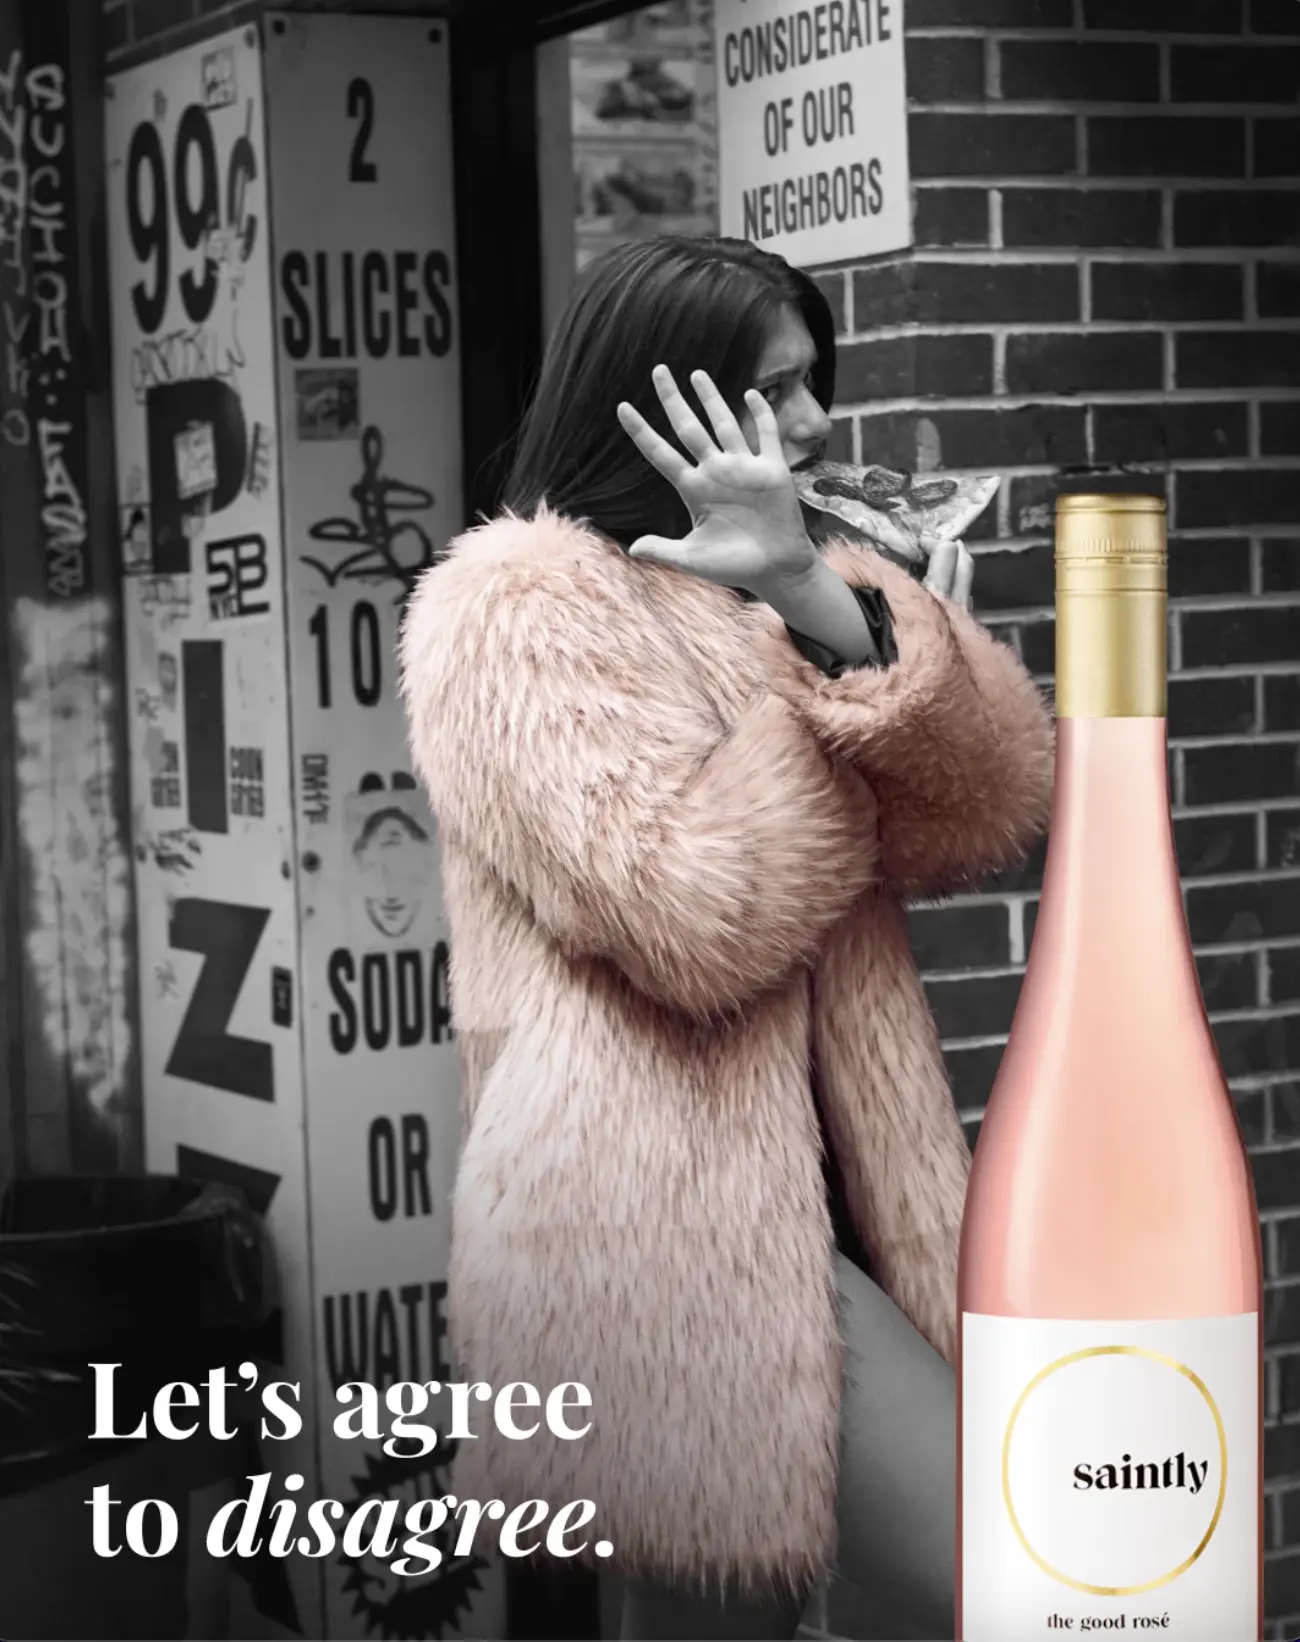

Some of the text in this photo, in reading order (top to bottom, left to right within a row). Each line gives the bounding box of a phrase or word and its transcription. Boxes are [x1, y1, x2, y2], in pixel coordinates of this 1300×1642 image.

[724, 0, 891, 88] CONSIDERATE
[346, 76, 378, 183] 2
[763, 81, 855, 157] OF OUR
[743, 157, 884, 241] NEIGHBORS
[280, 249, 453, 359] SLICES
[308, 600, 407, 708] 10
[327, 940, 453, 1054] SODA
[368, 1114, 432, 1222] OR
[323, 1281, 452, 1396] WATE
[1073, 1451, 1208, 1494] saintly
[1047, 1612, 1170, 1632] the good rosé
